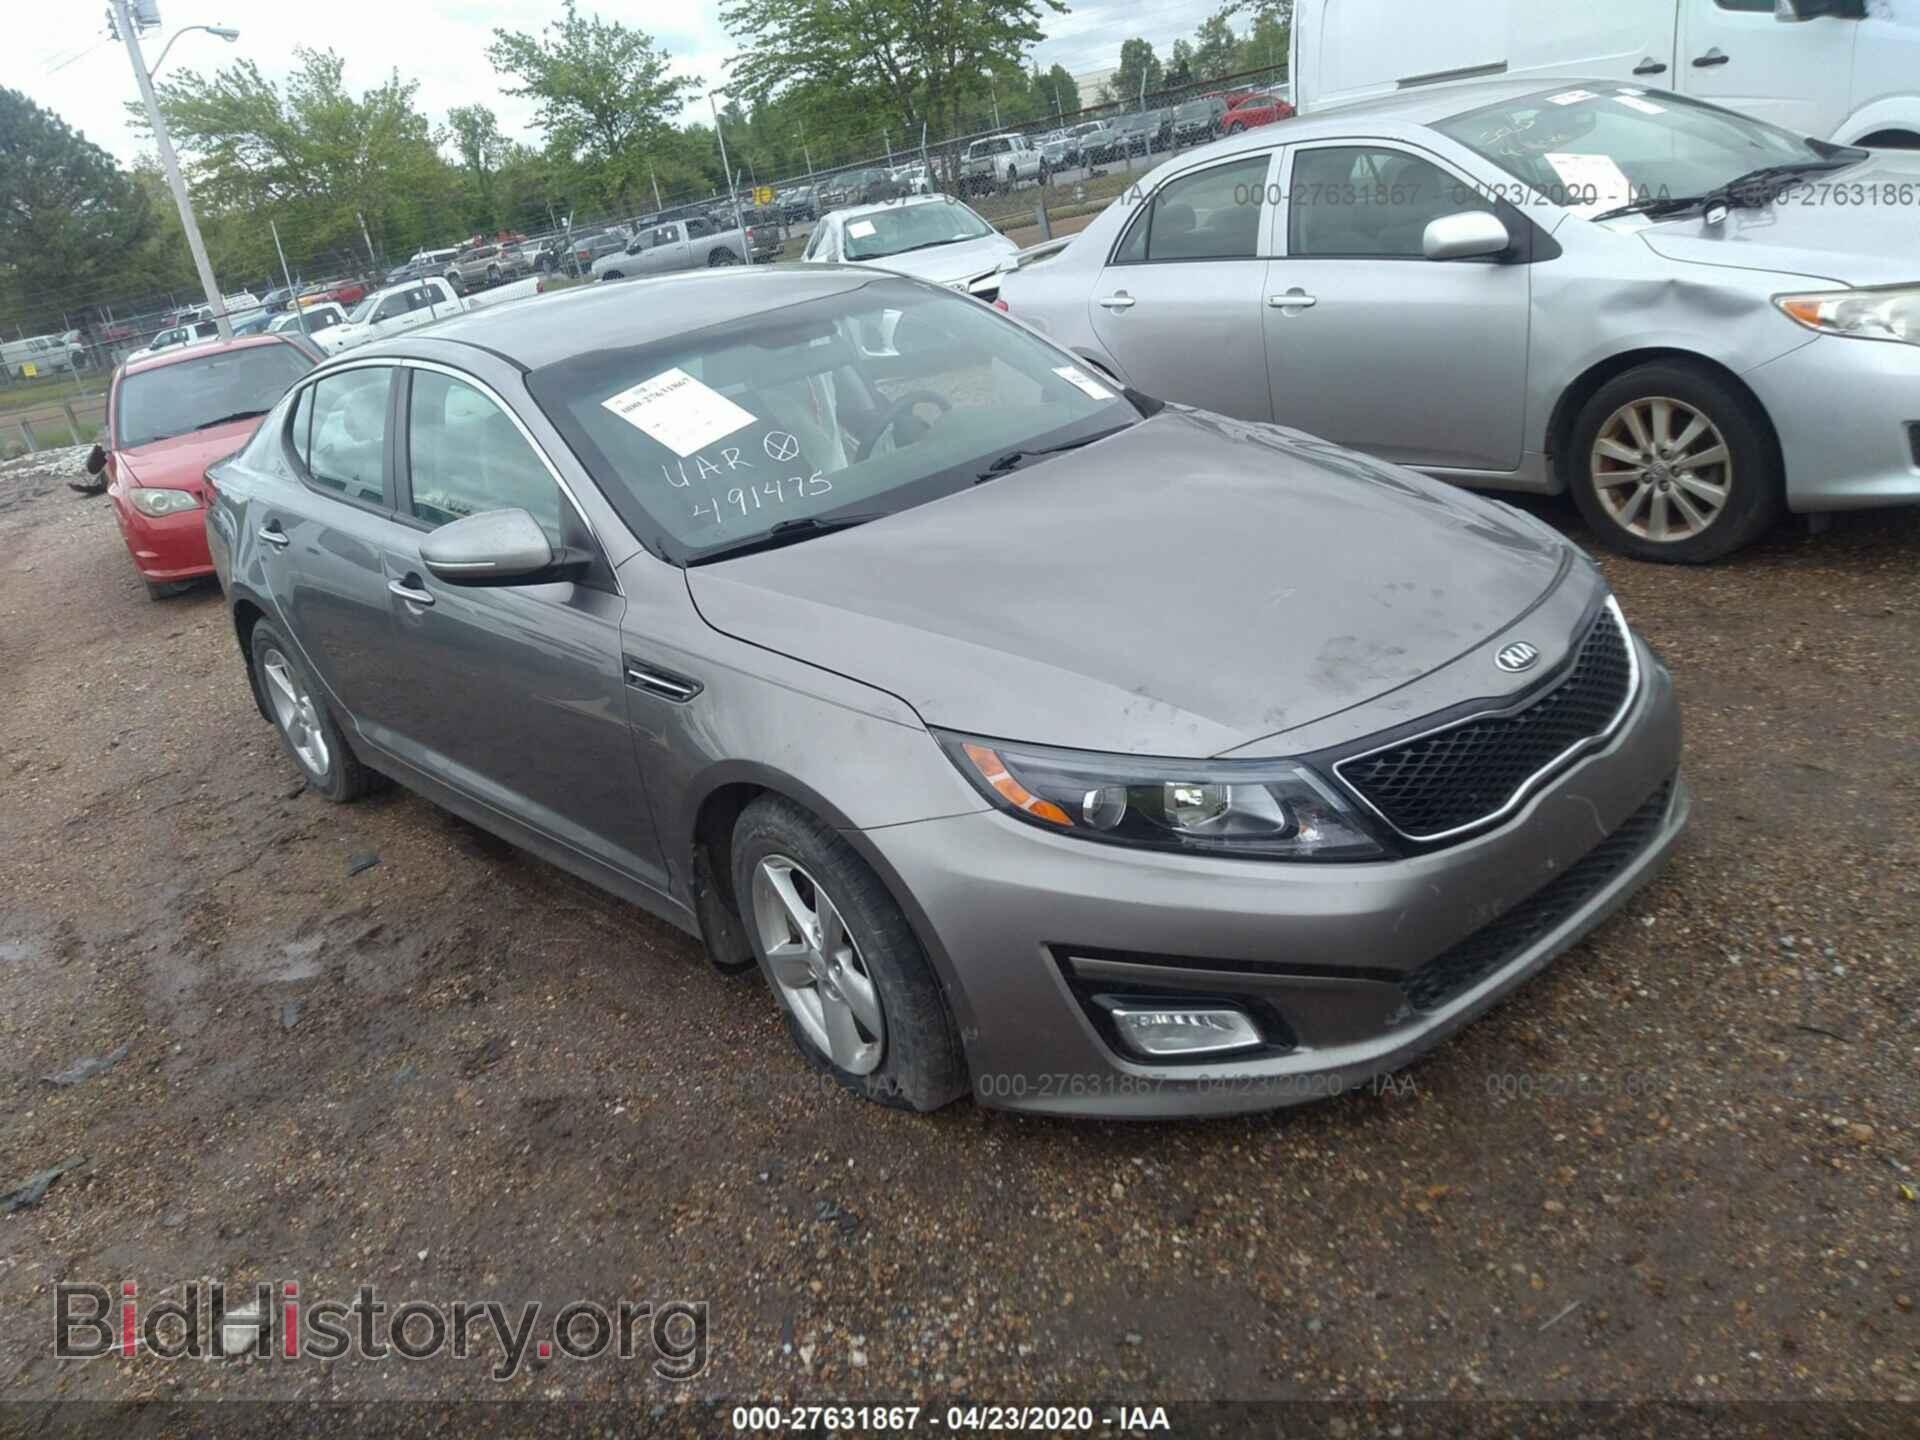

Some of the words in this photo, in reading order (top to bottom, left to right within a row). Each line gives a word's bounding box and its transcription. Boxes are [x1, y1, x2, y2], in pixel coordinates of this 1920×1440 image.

[662, 447, 753, 488] UAR
[691, 469, 833, 524] 491475
[1499, 642, 1538, 668] KIA
